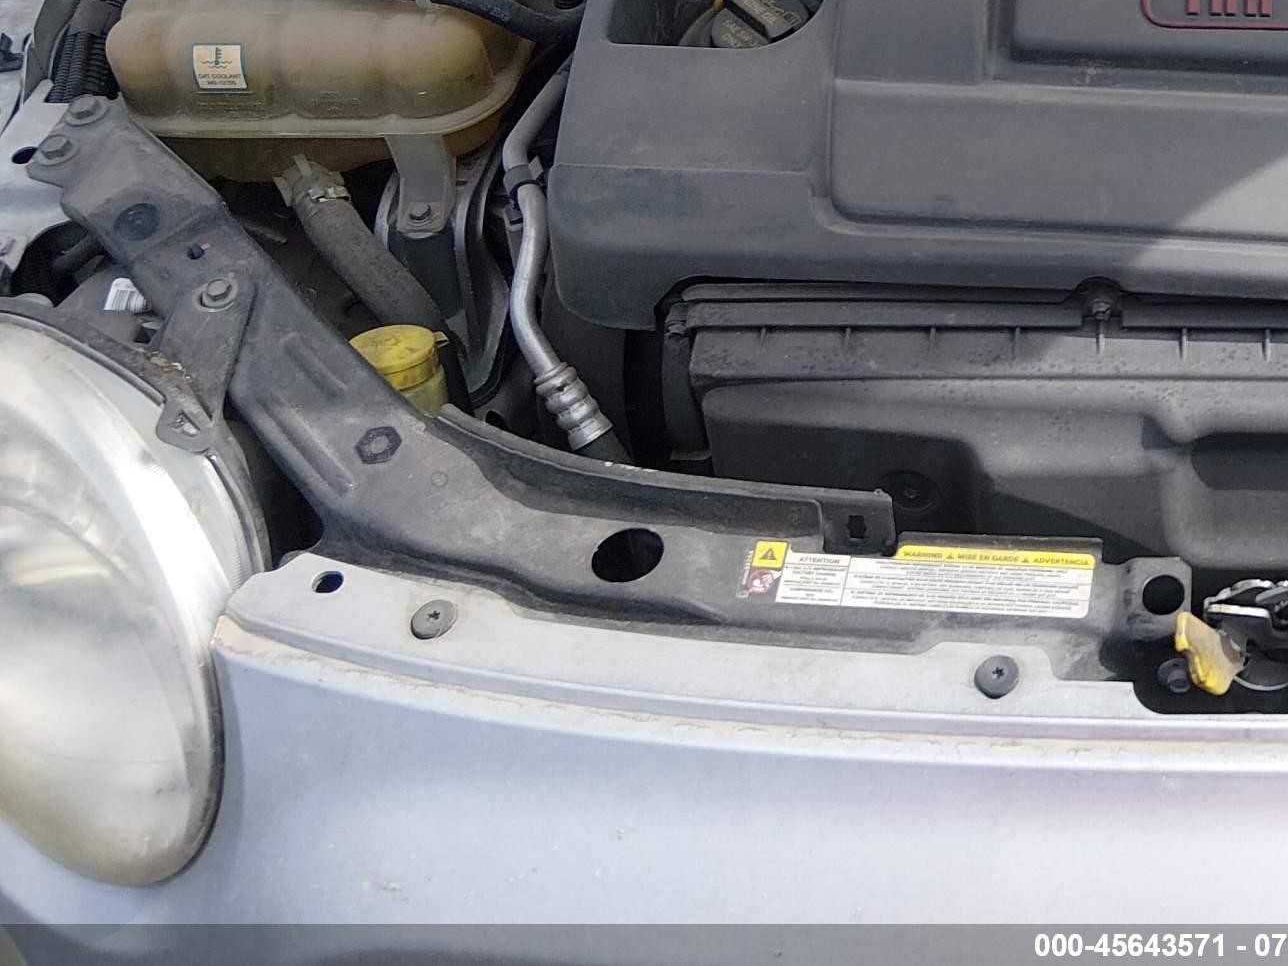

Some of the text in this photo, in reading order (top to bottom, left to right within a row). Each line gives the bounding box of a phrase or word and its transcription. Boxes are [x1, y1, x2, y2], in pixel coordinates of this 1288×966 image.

[799, 556, 840, 564] ATTENTION
[903, 550, 943, 559] WARNING
[1033, 556, 1090, 566] ADVERTENCIA
